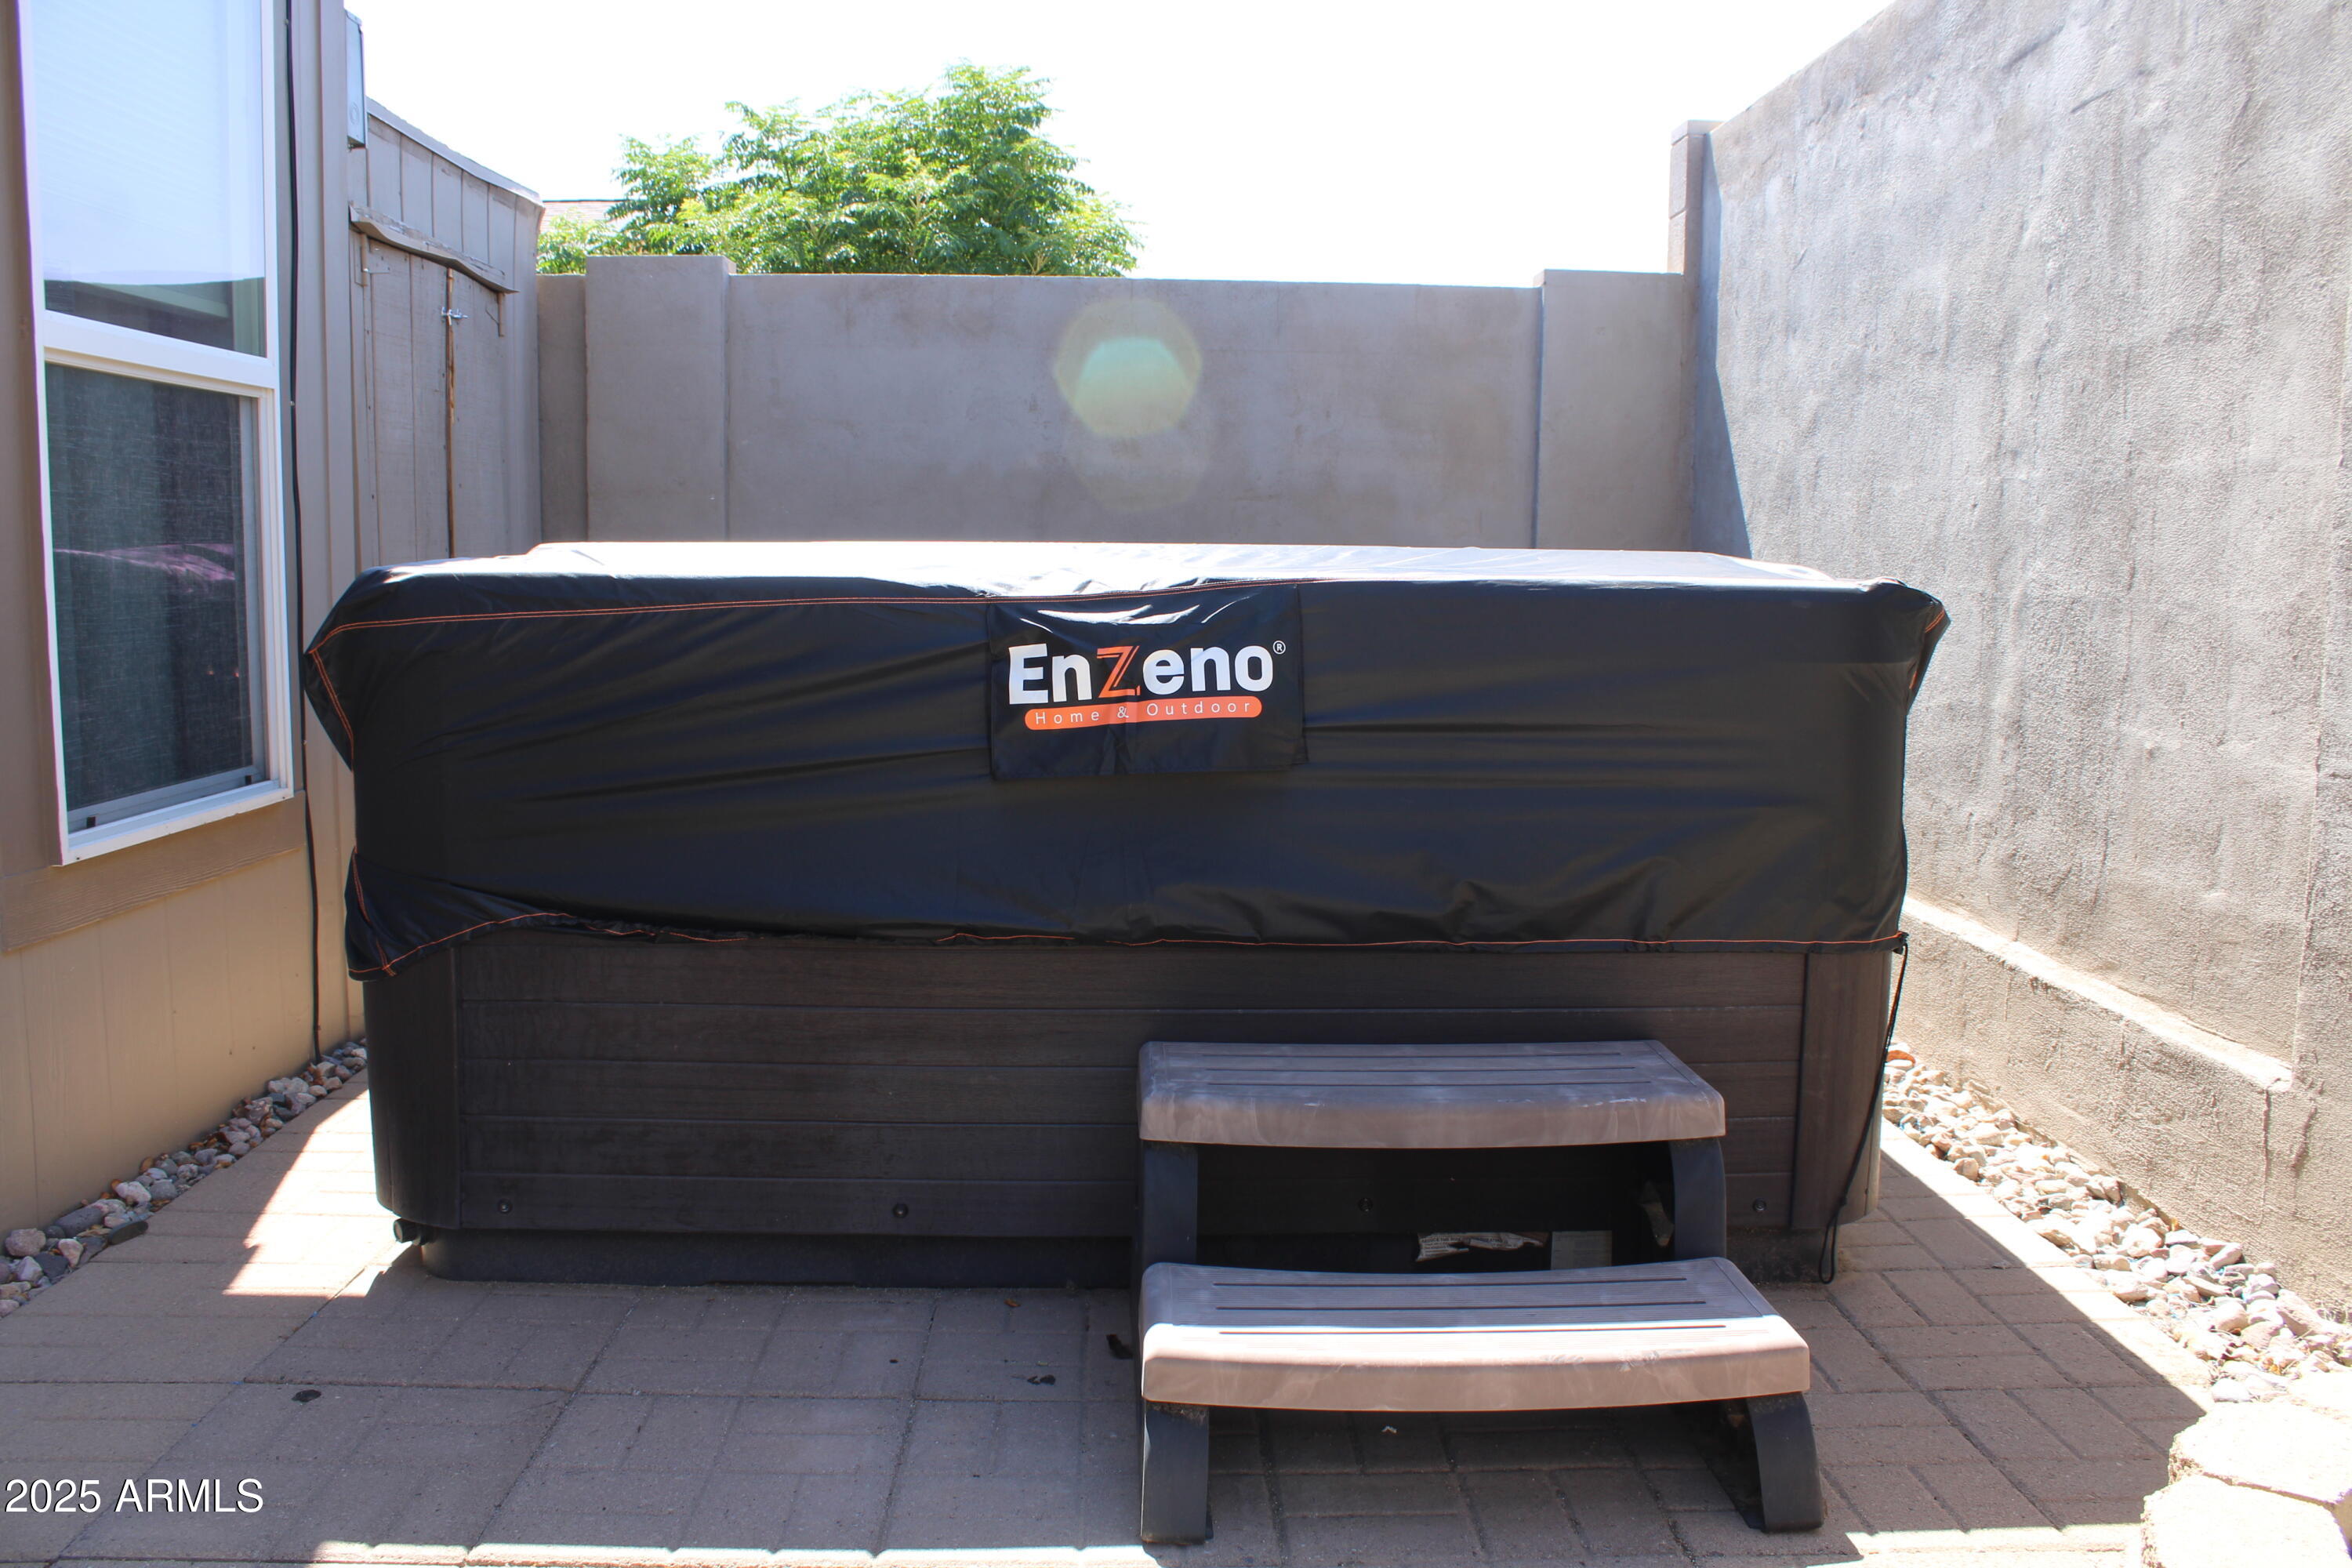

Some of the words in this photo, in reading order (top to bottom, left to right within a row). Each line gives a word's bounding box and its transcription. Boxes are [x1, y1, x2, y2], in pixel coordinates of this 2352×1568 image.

[1035, 710, 1100, 725] Home
[1116, 706, 1129, 719] &
[1146, 700, 1251, 717] Outdoor
